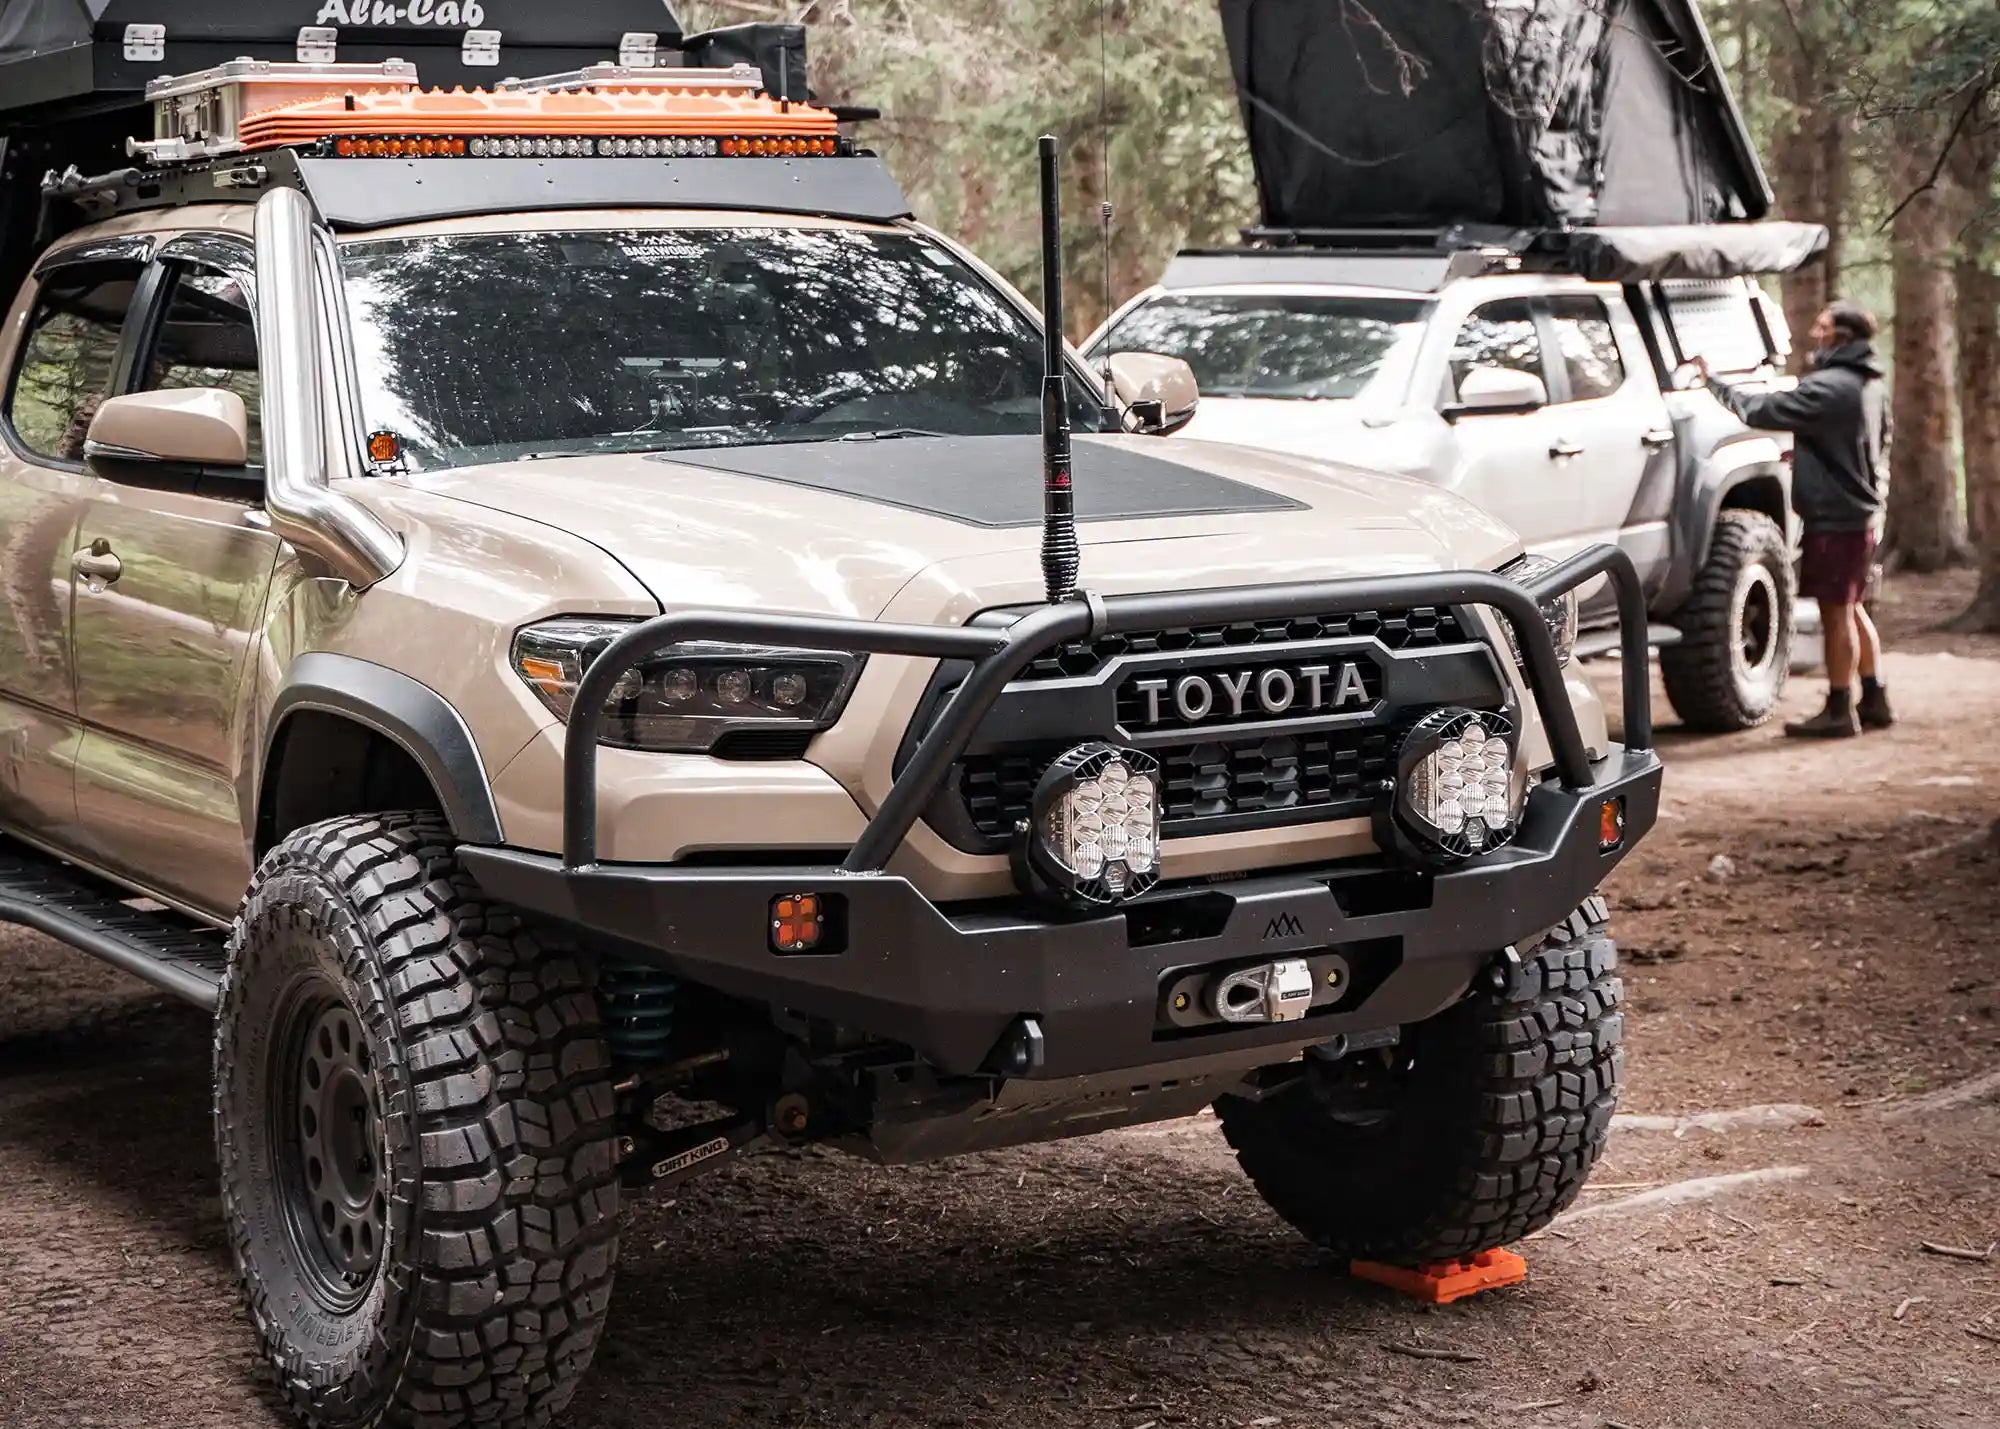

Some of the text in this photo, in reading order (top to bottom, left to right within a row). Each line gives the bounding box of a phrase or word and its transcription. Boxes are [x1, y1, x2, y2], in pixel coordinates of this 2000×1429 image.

[316, 0, 484, 27] Alu-Cab
[622, 245, 705, 256] BACKWOODS
[1136, 662, 1370, 724] TOYOTA
[659, 1140, 723, 1174] DIRT KING
